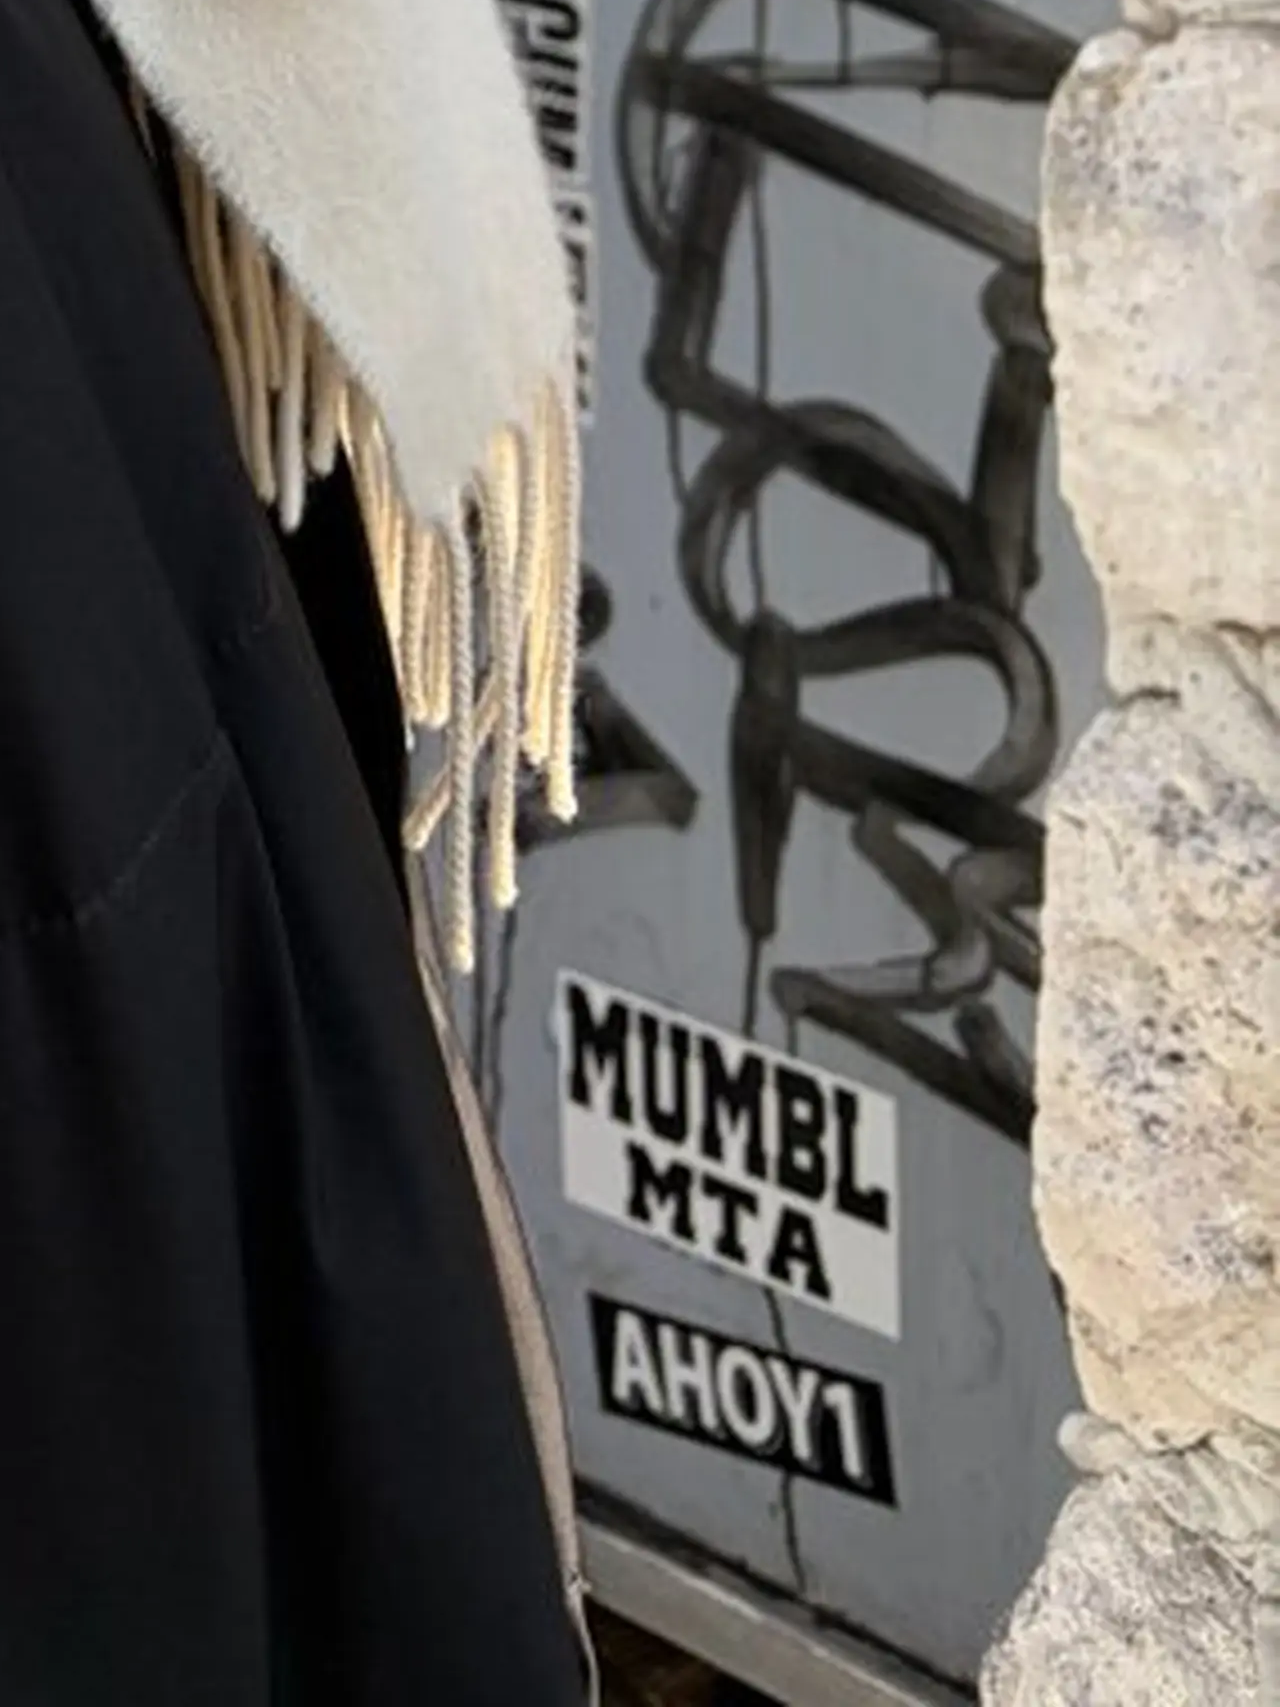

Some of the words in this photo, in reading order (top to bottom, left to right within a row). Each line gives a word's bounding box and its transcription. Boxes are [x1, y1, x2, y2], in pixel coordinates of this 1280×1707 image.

[568, 985, 889, 1232] MUMBL
[626, 1141, 831, 1301] MTA
[613, 1309, 865, 1480] AHOY1
